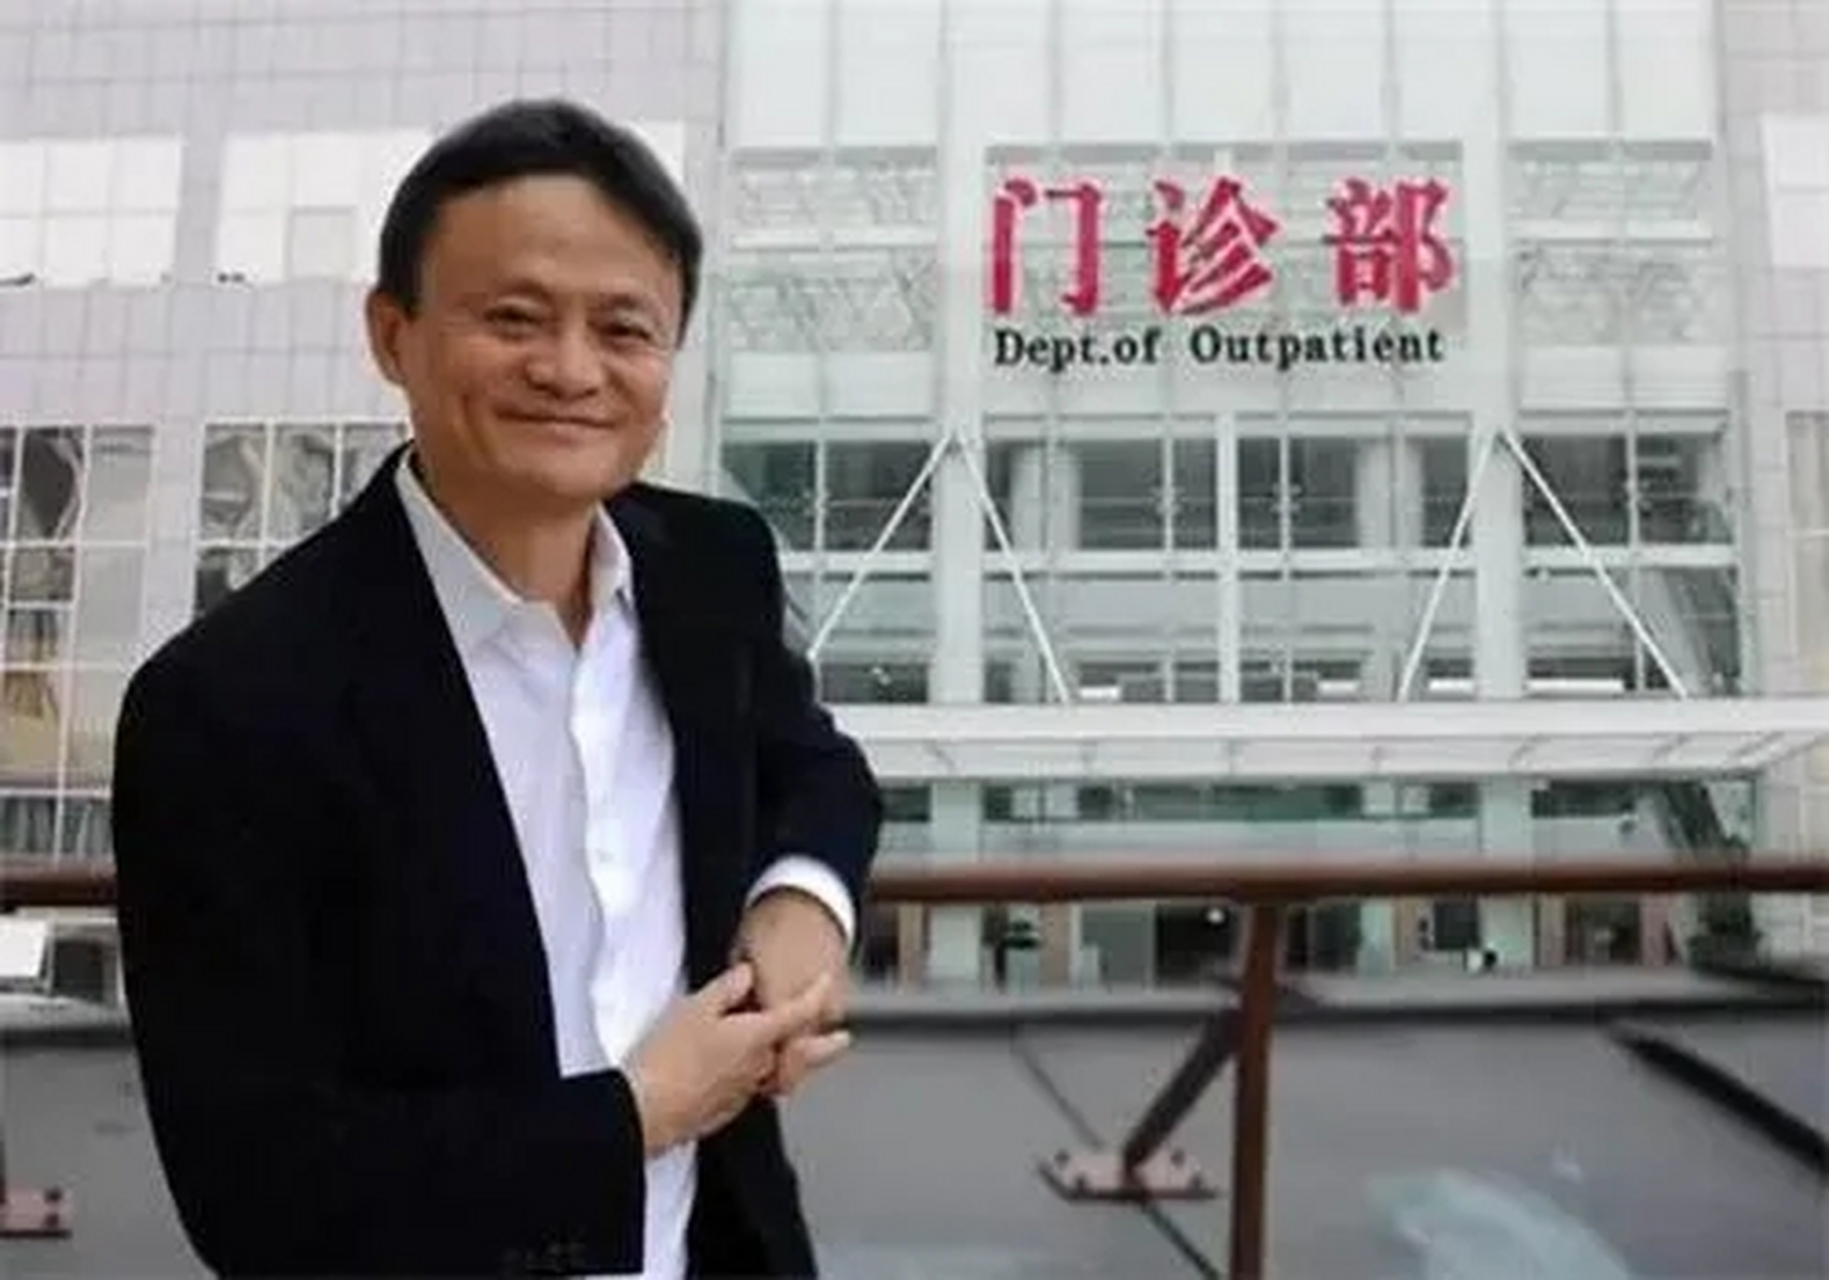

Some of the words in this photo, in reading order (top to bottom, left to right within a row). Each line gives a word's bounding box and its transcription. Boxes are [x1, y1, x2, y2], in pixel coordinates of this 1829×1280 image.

[990, 176, 1454, 316] 门诊部
[1189, 326, 1446, 371] Outpatient
